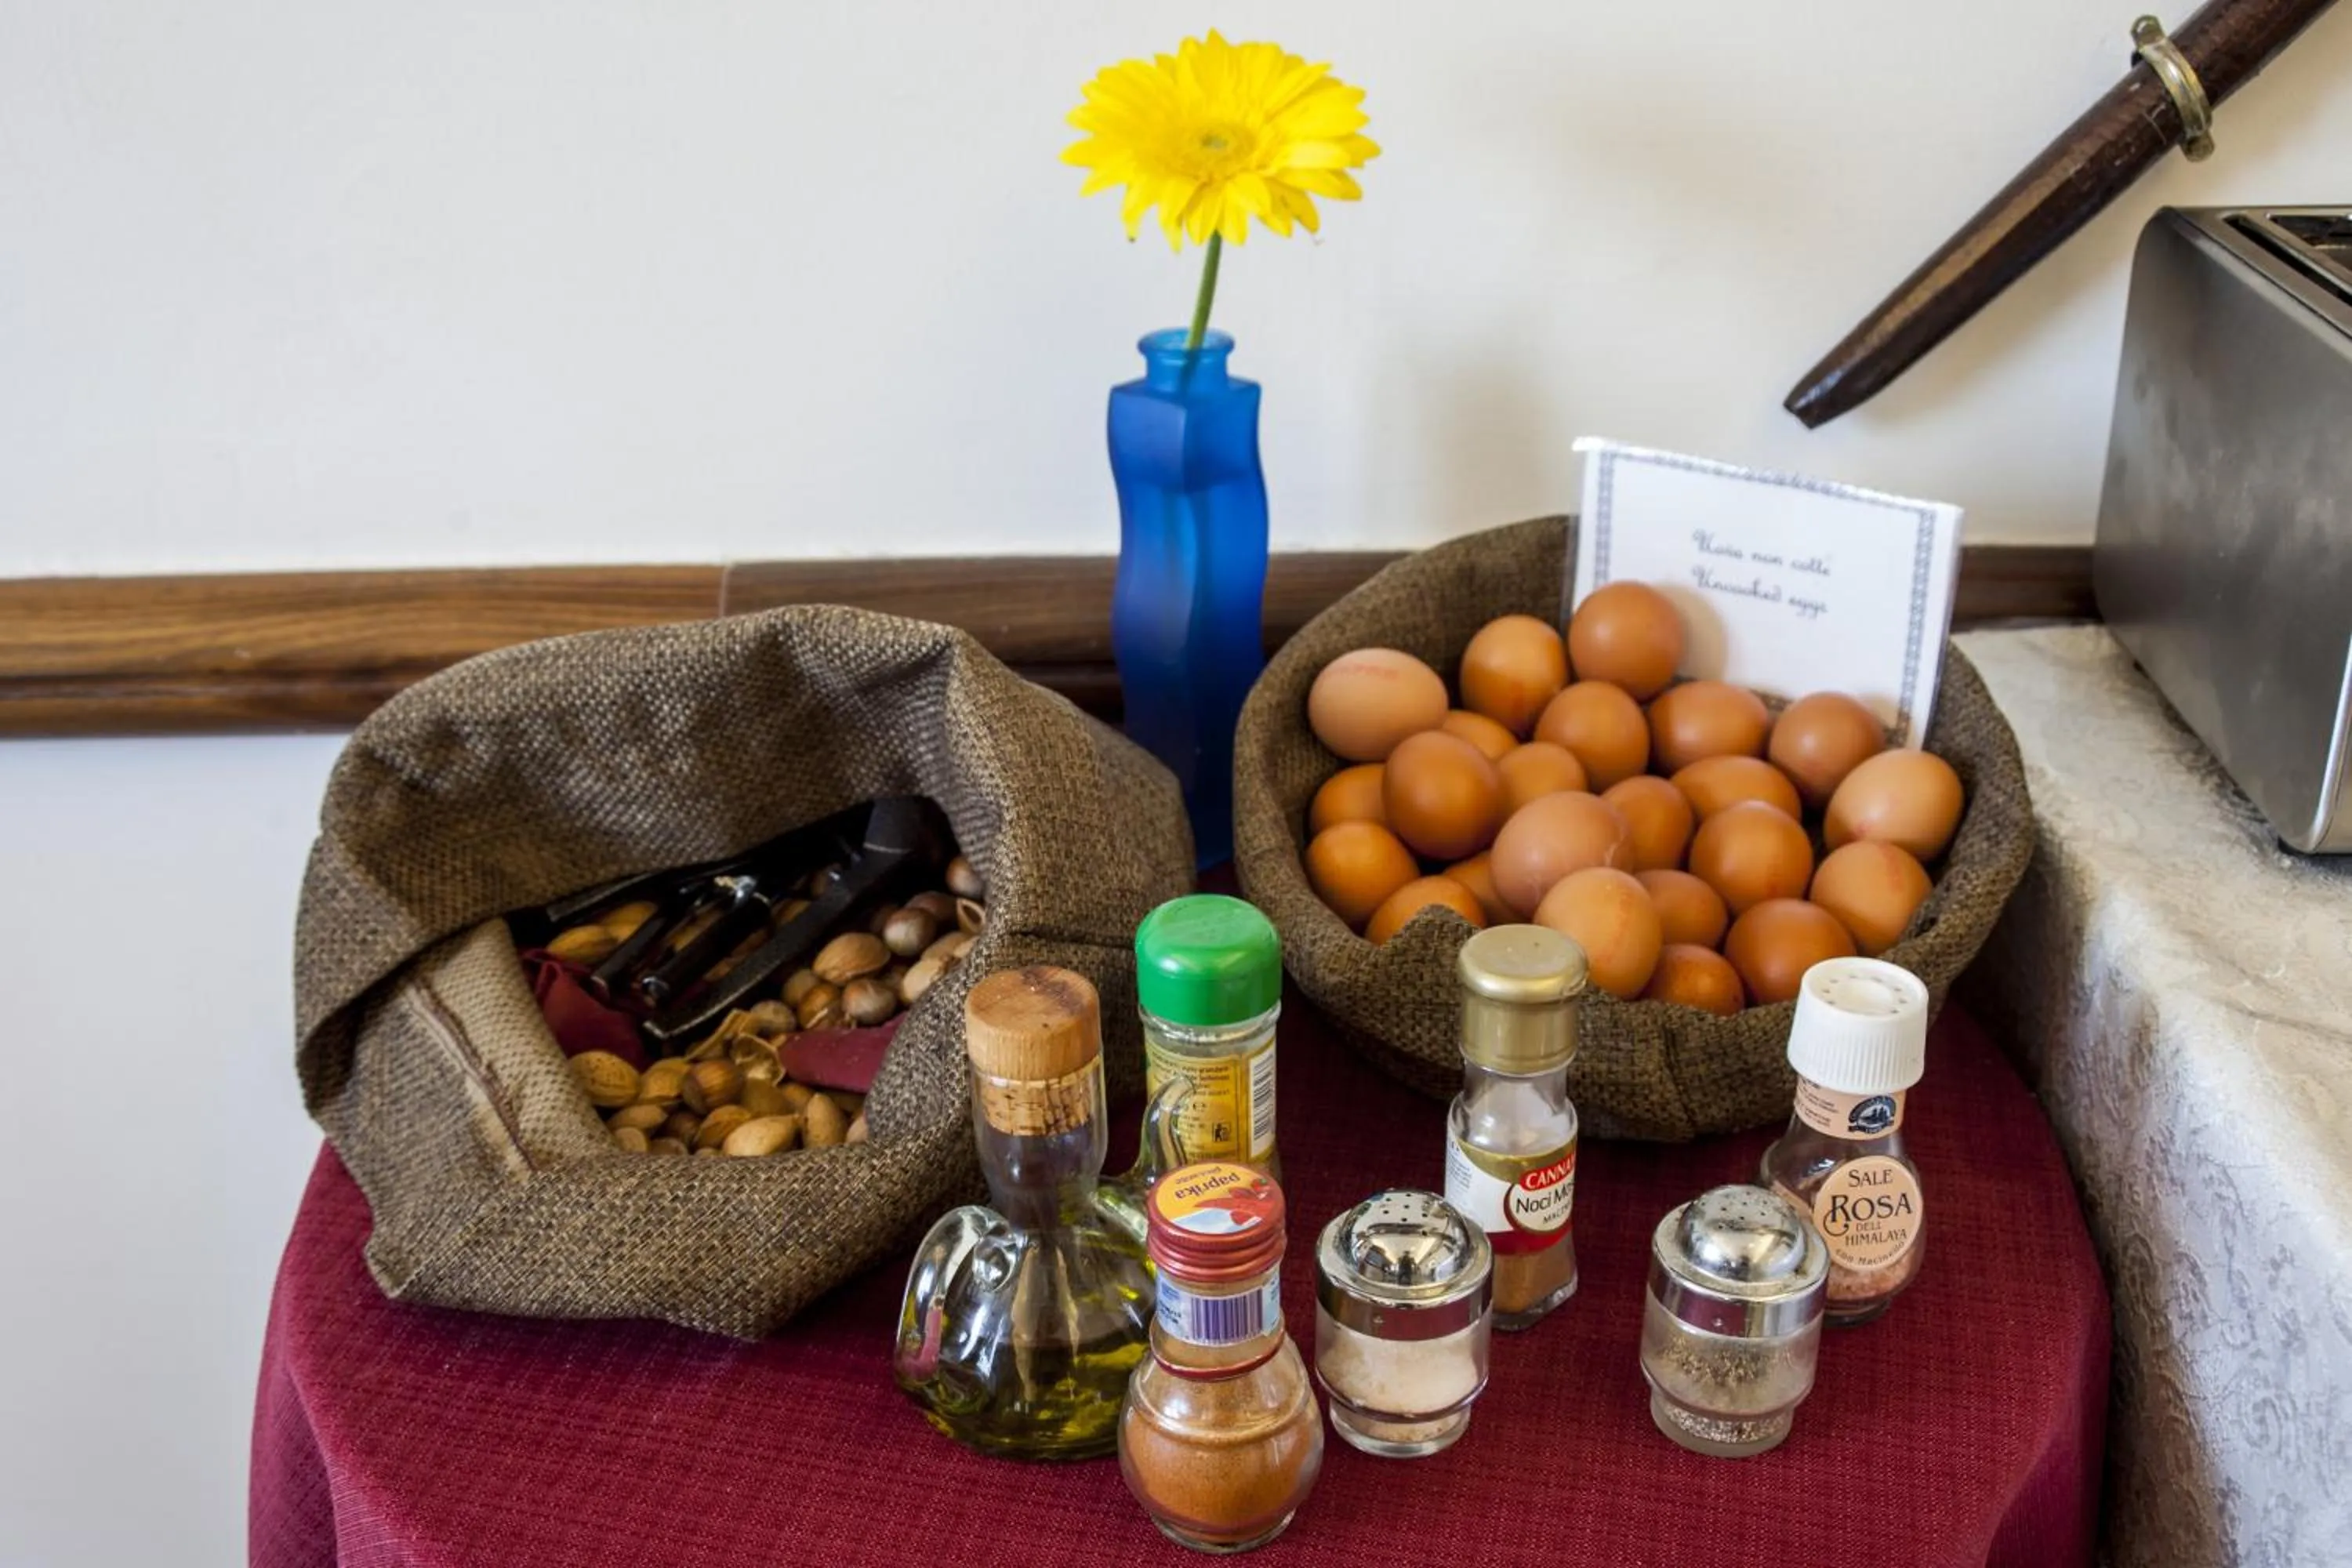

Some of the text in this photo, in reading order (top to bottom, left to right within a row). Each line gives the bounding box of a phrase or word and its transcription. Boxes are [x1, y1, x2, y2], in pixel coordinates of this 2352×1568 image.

[1175, 1172, 1241, 1200] paprika
[1847, 1168, 1894, 1189] SALE
[1823, 1192, 1913, 1237] ROSA
[1844, 1228, 1907, 1247] HIMALAYA
